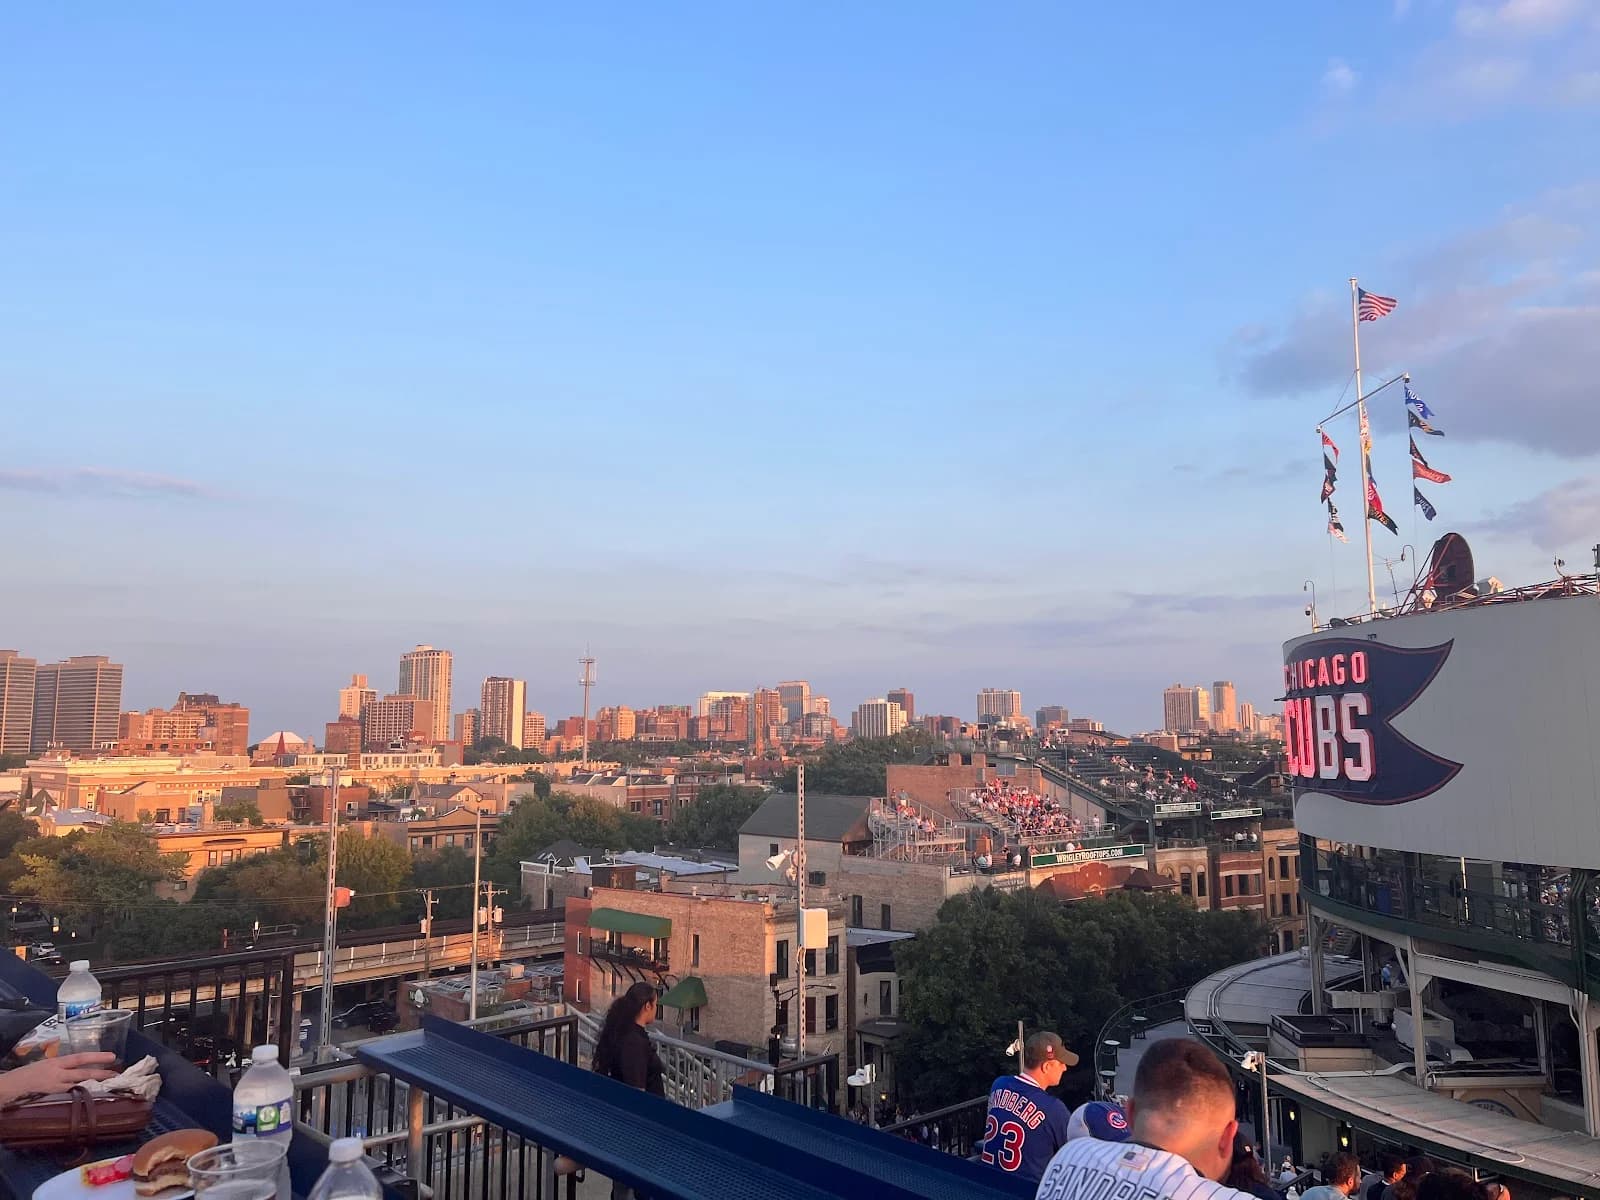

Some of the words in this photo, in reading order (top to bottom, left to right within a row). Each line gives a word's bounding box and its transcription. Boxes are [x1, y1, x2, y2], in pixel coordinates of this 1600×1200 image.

[1283, 651, 1366, 690] CHICAGO
[1284, 693, 1374, 781] CUBS
[981, 1115, 1025, 1172] 23
